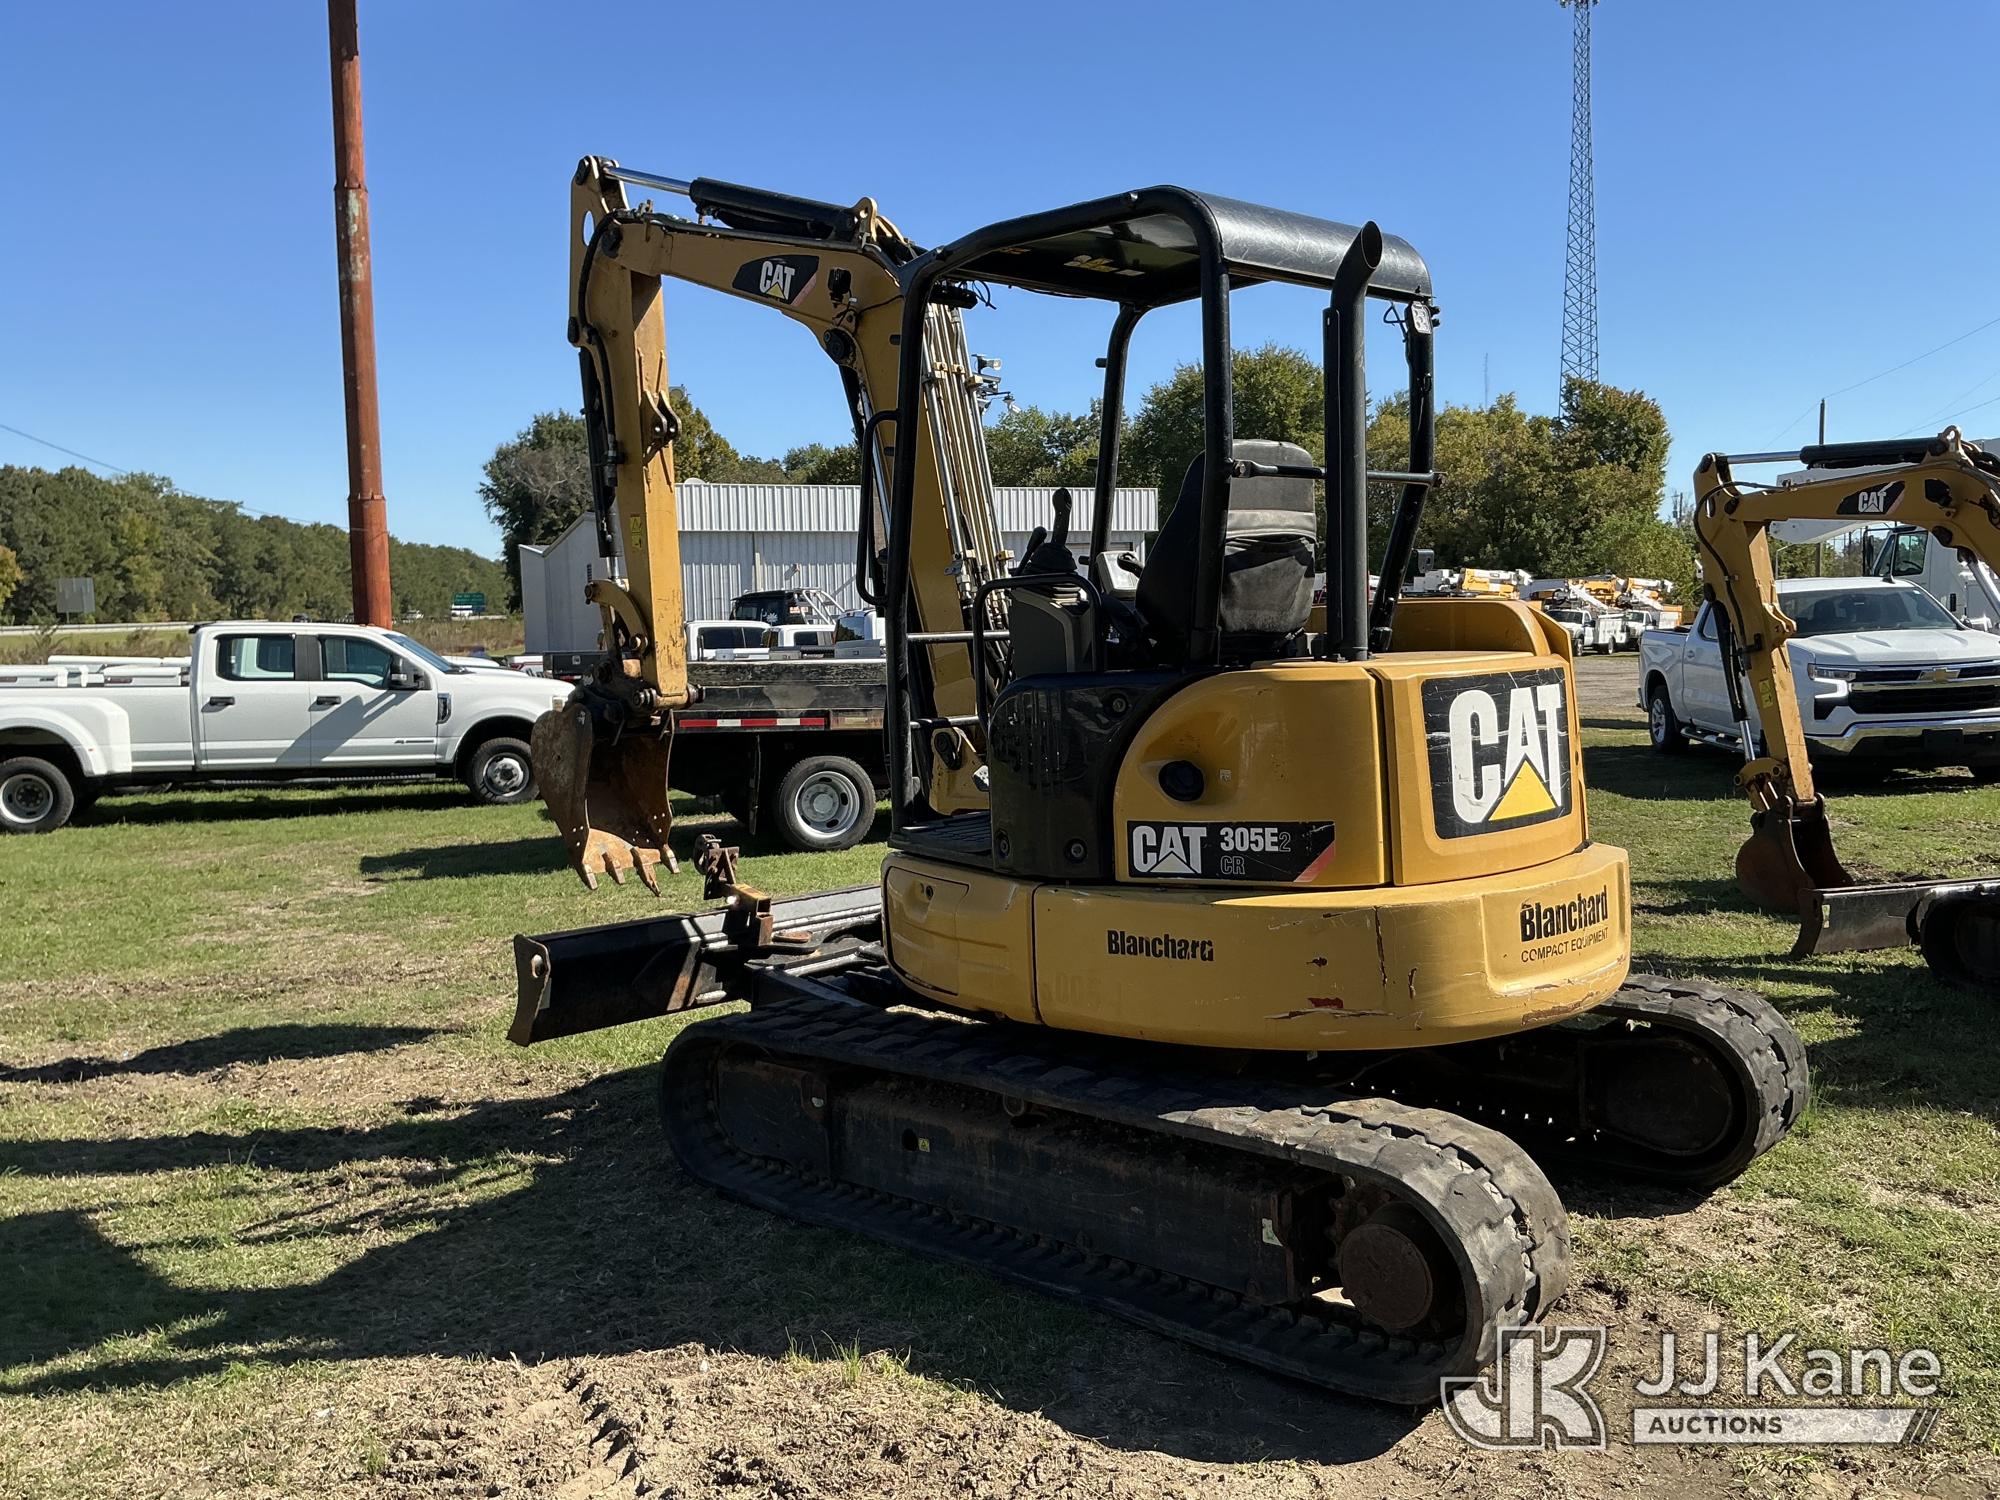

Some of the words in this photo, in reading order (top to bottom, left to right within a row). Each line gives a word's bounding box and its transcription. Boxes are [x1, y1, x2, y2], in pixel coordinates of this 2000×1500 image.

[760, 260, 796, 300] CAT
[1858, 491, 1887, 513] CAT
[1449, 683, 1562, 824] CAT
[1132, 825, 1207, 874] CAT
[1220, 855, 1246, 875] CR
[1520, 884, 1608, 943] Blanchard
[1521, 941, 1569, 963] COMPACT
[1571, 926, 1609, 952] EQUIPMENT
